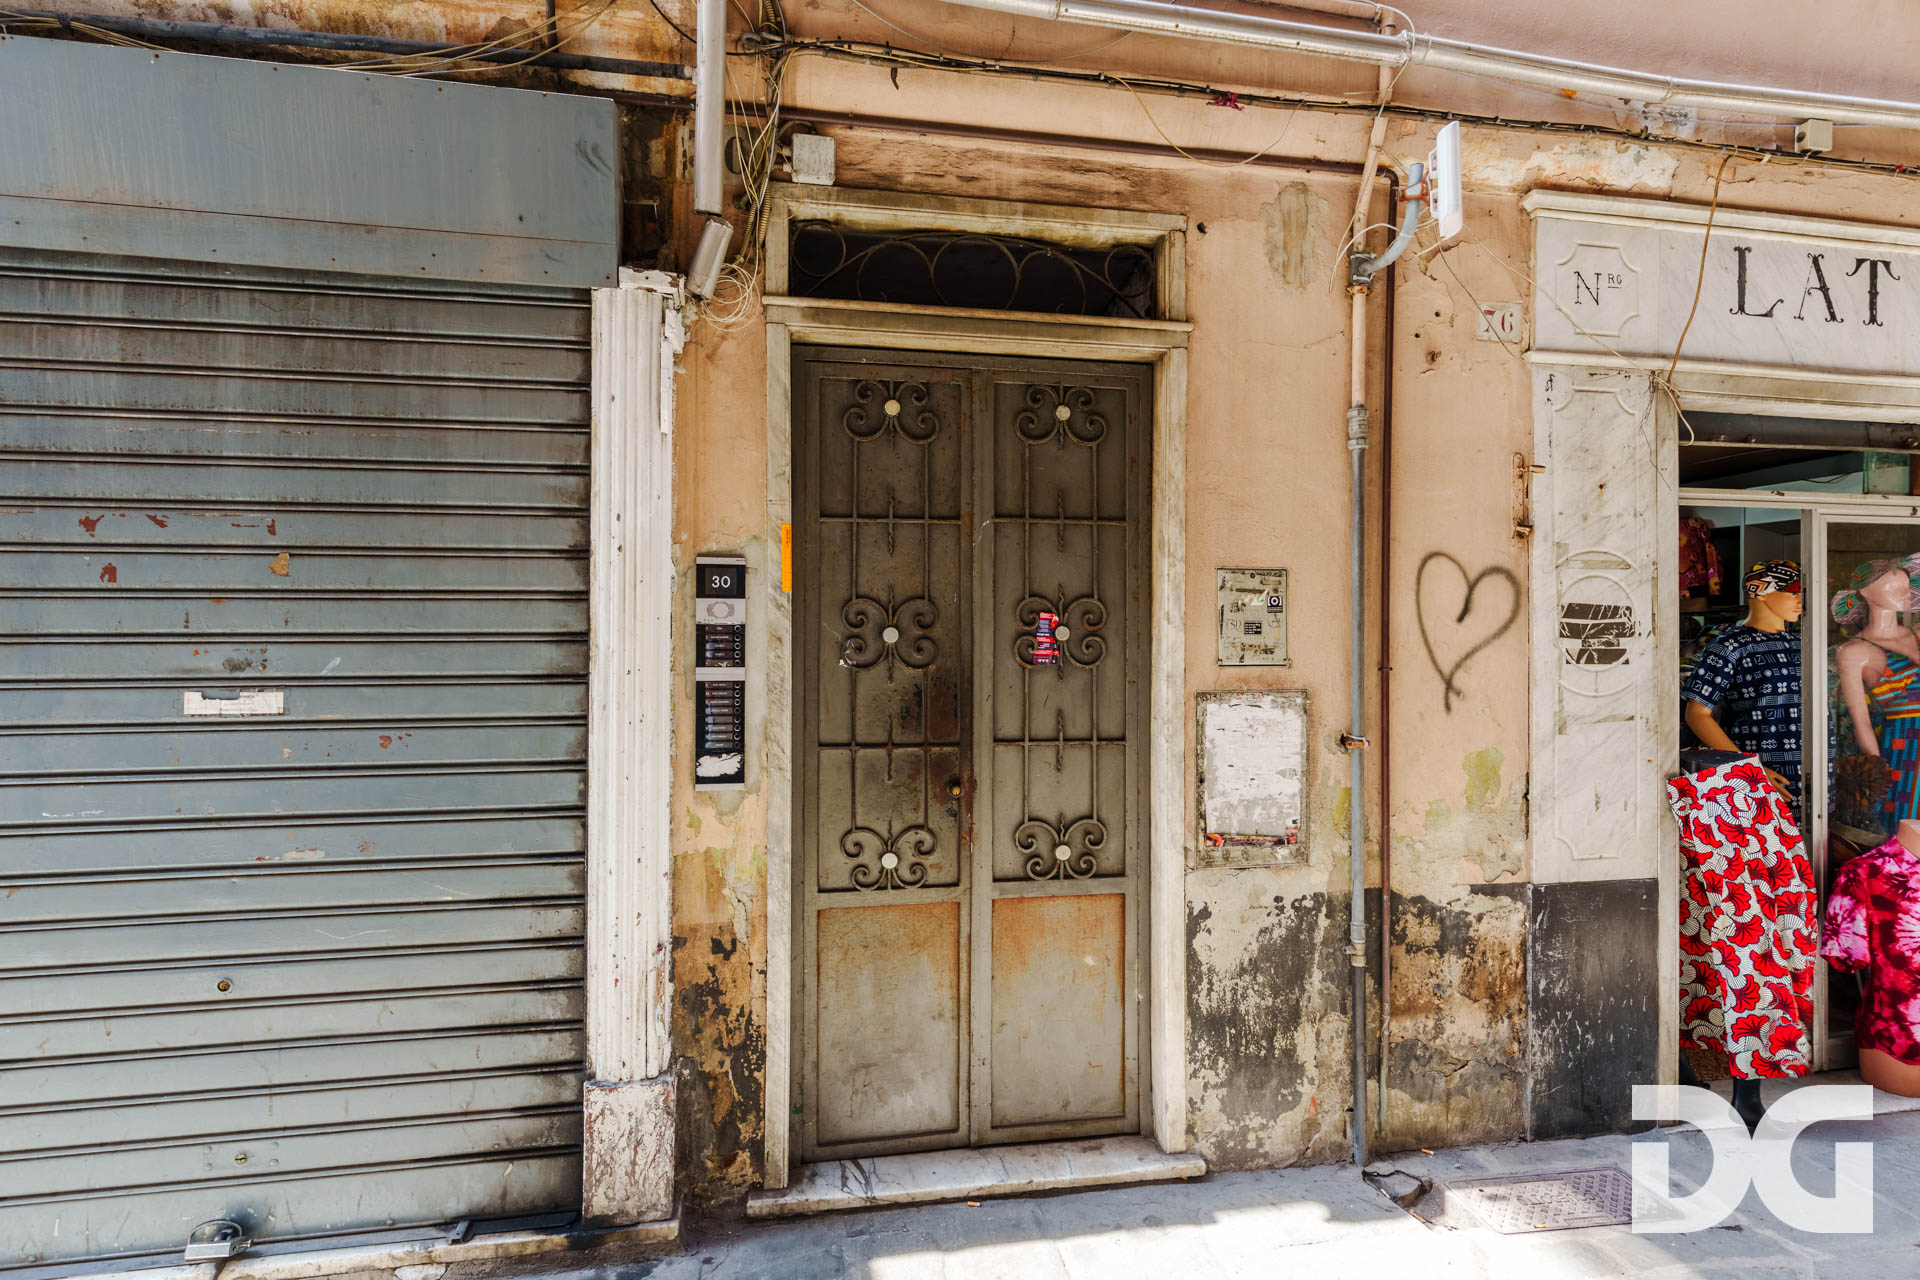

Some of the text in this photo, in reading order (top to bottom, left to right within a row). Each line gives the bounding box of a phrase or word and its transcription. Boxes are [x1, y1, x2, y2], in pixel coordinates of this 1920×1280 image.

[1729, 246, 1901, 327] LAT
[711, 575, 731, 589] 30
[1516, 1191, 1604, 1207] ACQUEDOTTO
